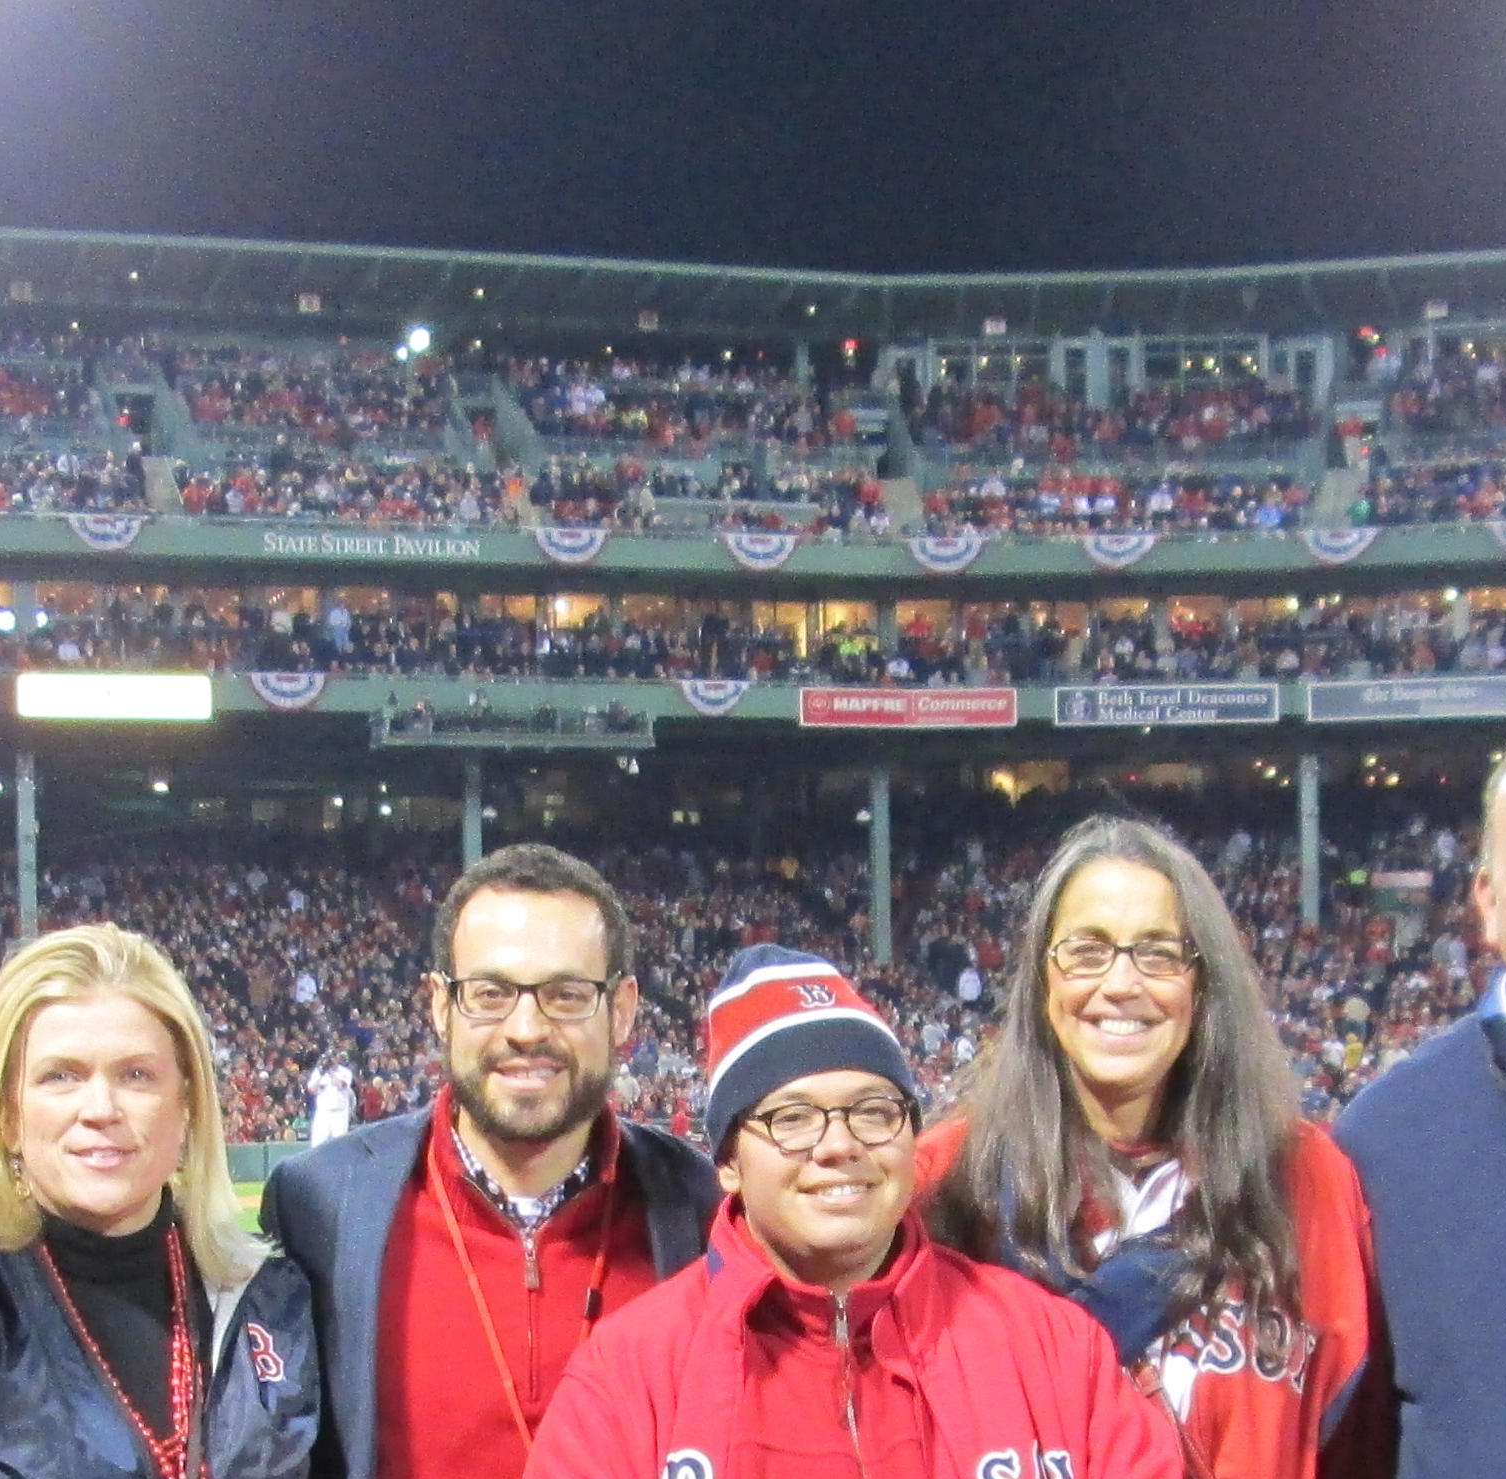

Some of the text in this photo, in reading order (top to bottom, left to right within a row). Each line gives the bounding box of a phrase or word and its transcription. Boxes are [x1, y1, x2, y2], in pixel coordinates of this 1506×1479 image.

[394, 533, 480, 557] PAVILION
[833, 695, 1008, 712] MAPFRE Commerce
[1098, 688, 1268, 705] Beth Israel Deaconess
[1097, 704, 1218, 721] Medical Center
[247, 1322, 285, 1382] B
